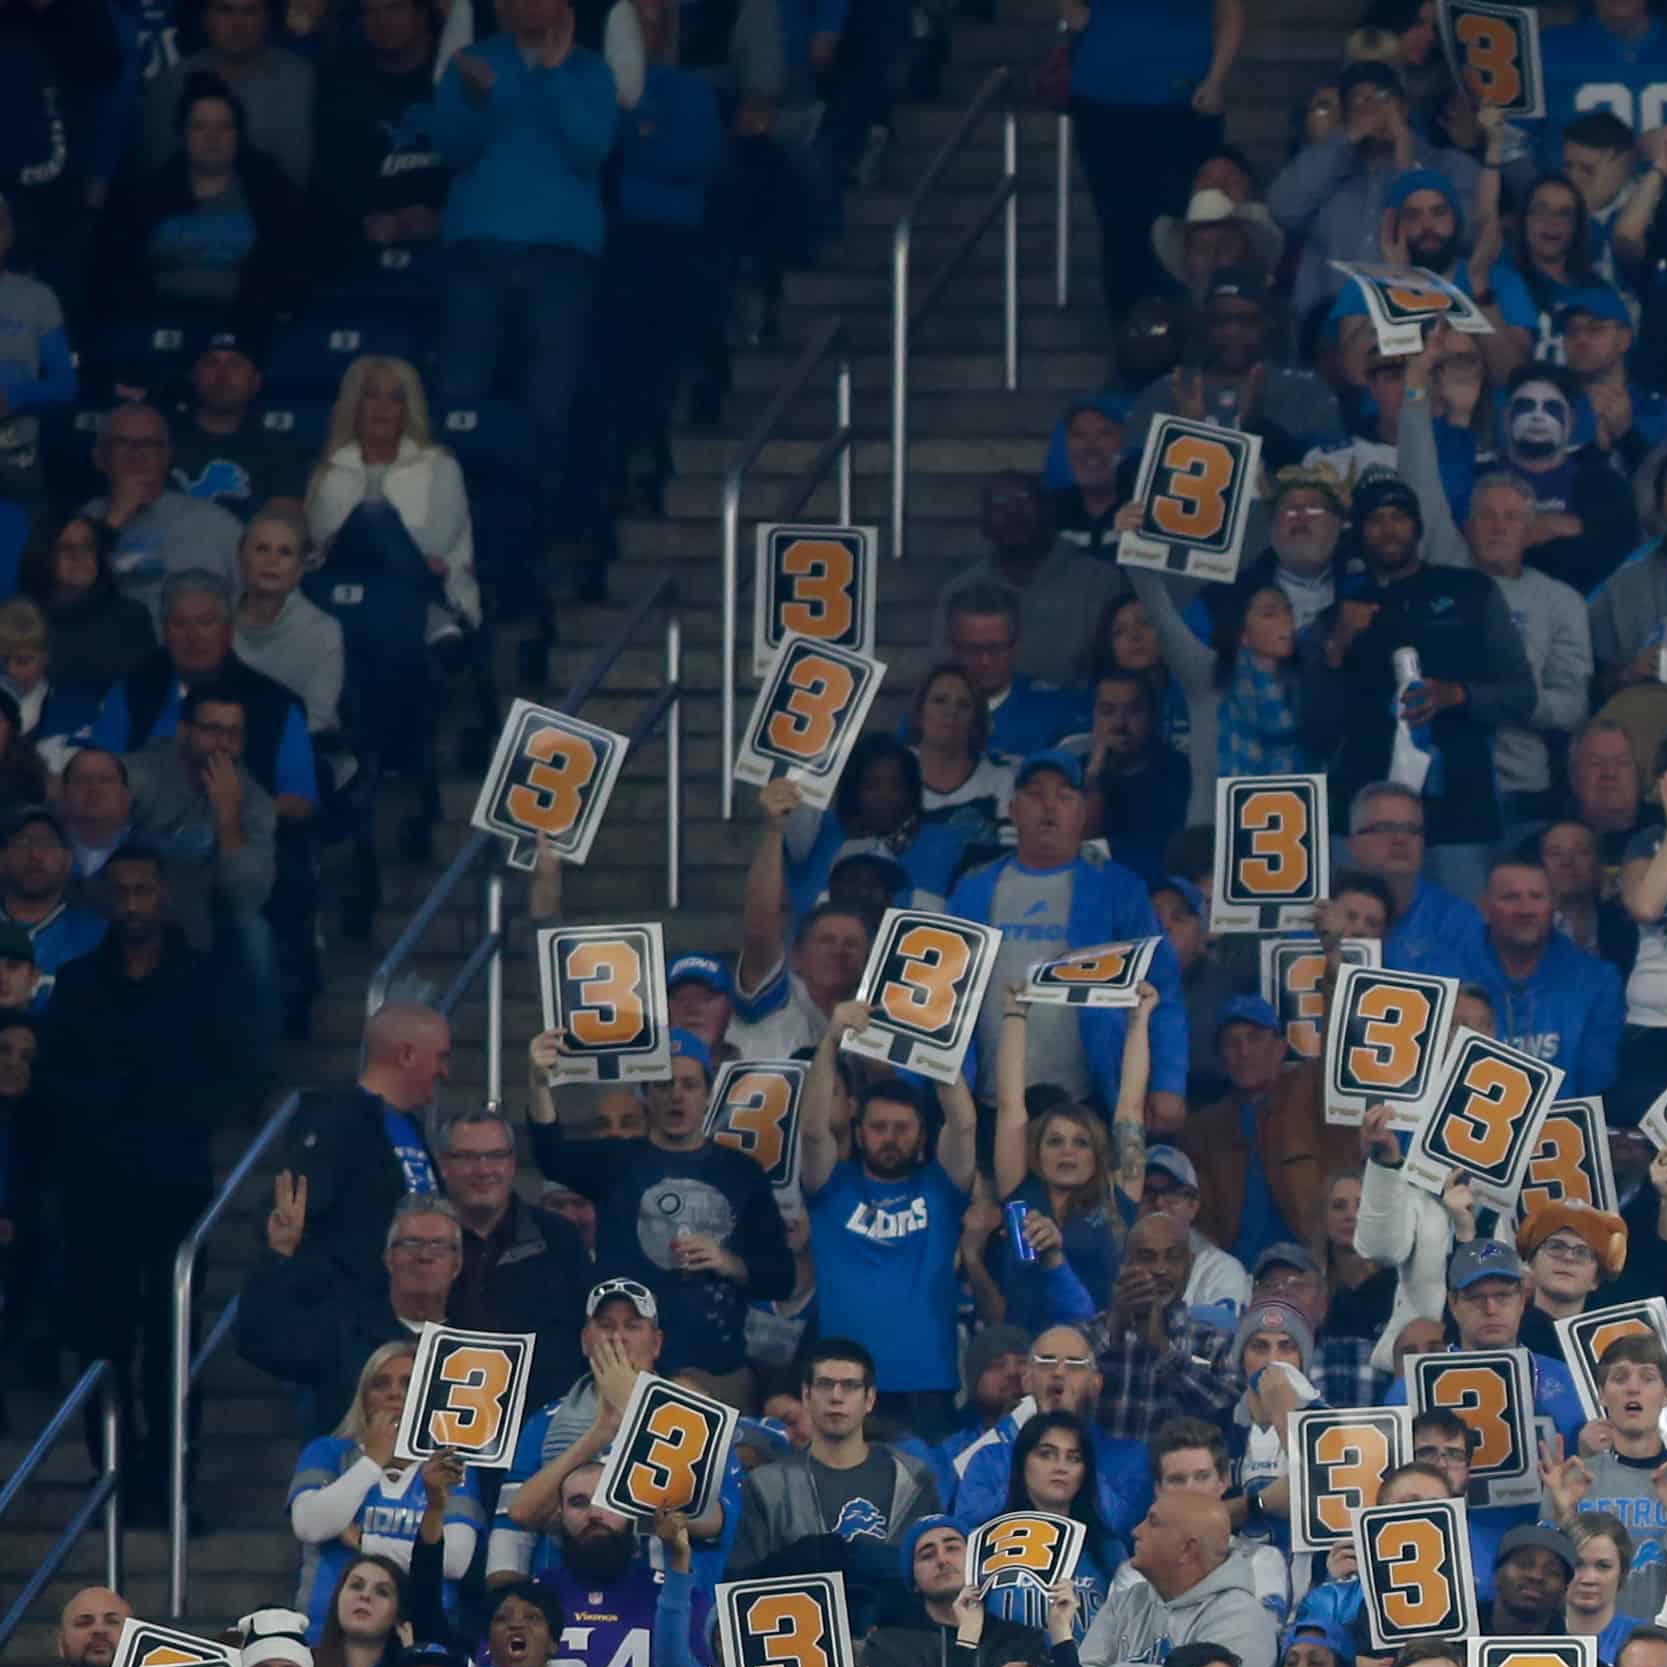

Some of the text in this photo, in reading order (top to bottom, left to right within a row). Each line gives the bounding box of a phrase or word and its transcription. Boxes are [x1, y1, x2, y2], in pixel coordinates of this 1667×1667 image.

[1154, 438, 1234, 538] 3
[781, 541, 853, 639] 3
[769, 658, 852, 755] 3
[508, 735, 595, 833] 3
[1240, 793, 1307, 893] 3
[569, 945, 643, 1045] 3
[882, 928, 968, 1031] 3
[1350, 986, 1429, 1085] 3
[1443, 1059, 1532, 1167] 3
[432, 1350, 511, 1448] 3
[628, 1403, 709, 1512] 3
[1377, 1521, 1449, 1628] 3
